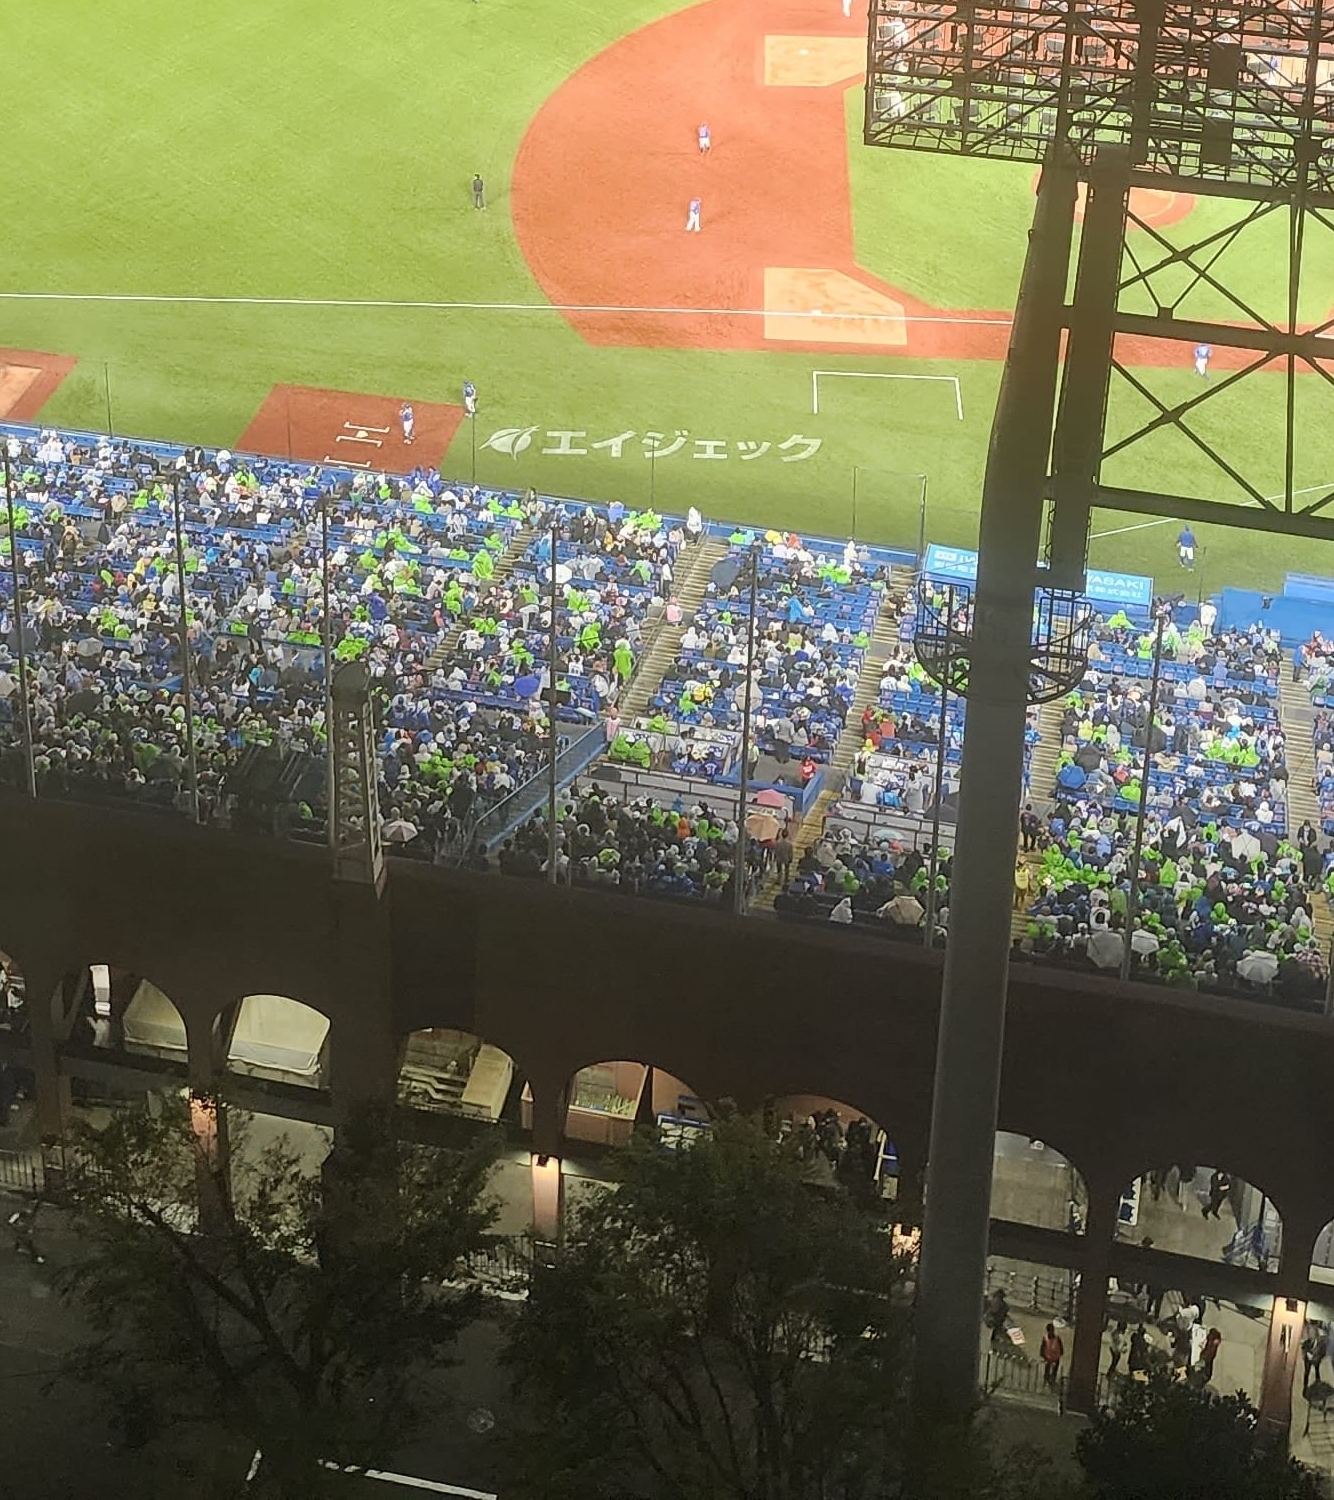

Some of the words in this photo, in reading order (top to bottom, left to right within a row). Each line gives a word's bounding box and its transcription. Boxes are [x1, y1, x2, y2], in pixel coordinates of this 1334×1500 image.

[541, 428, 823, 463] エイジェック
